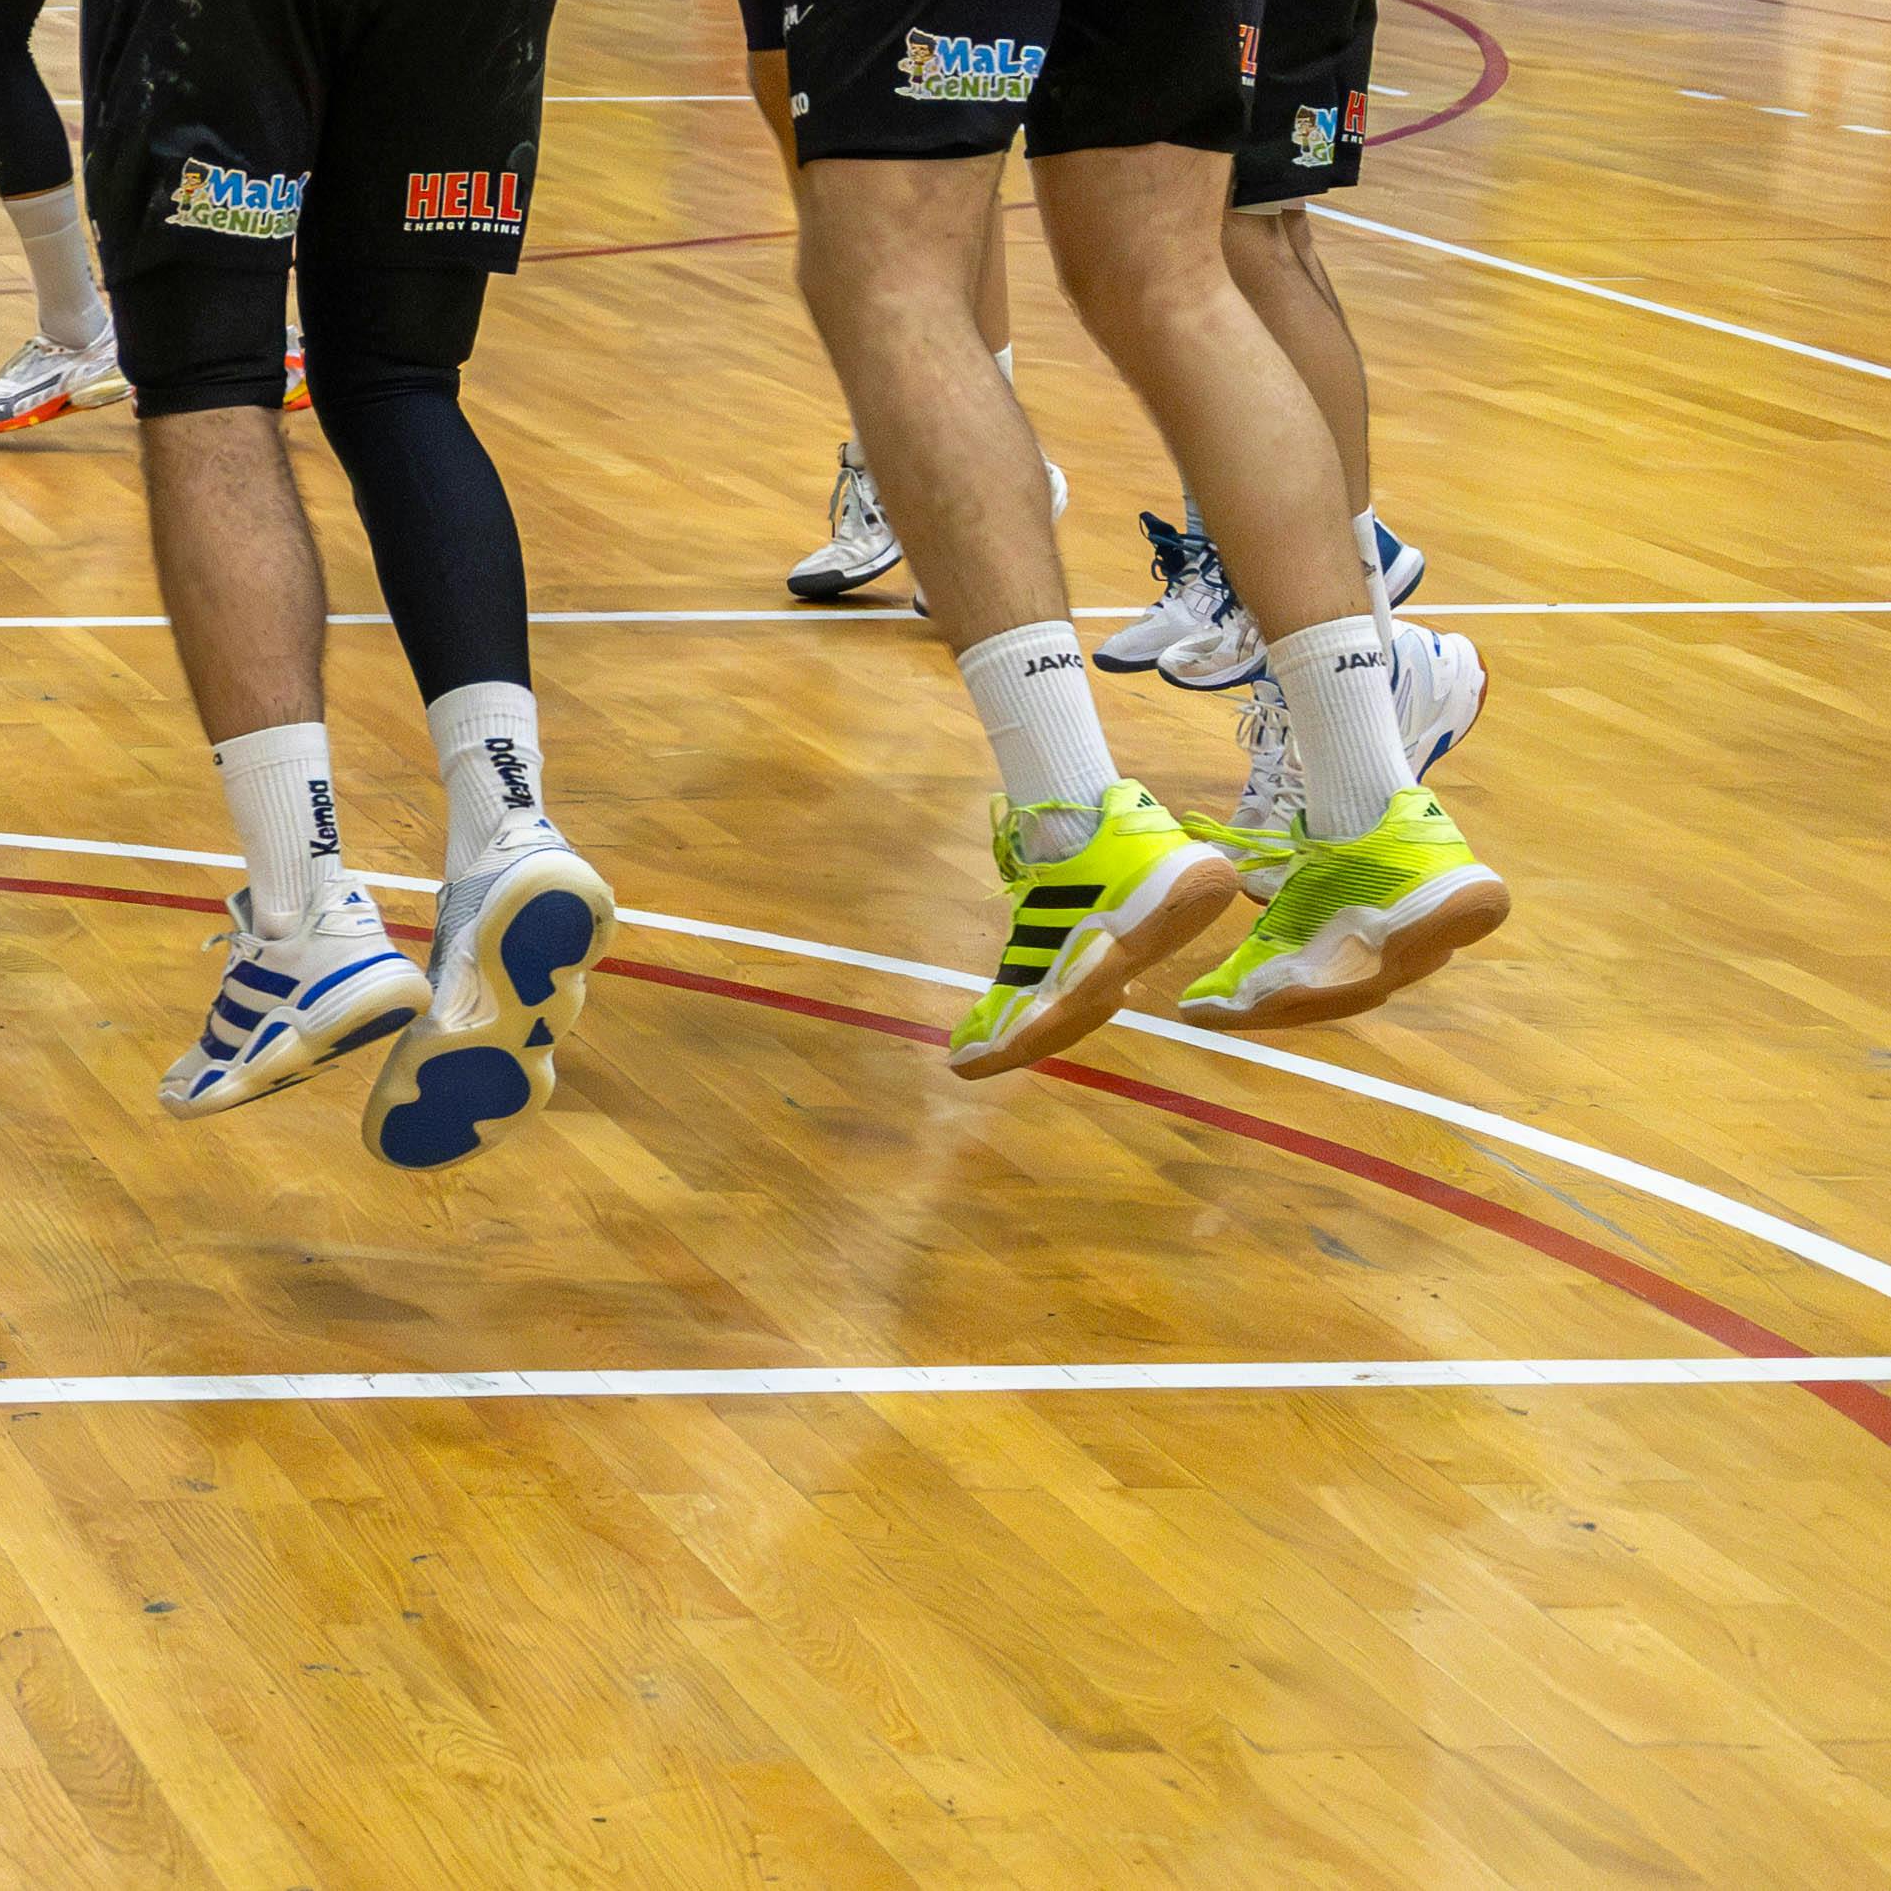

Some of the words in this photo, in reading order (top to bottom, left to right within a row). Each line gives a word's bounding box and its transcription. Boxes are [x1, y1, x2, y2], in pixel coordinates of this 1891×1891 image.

[406, 171, 523, 223] HELL
[404, 221, 465, 232] ENERGY
[471, 222, 520, 235] DRINK
[309, 779, 341, 860] Kempa
